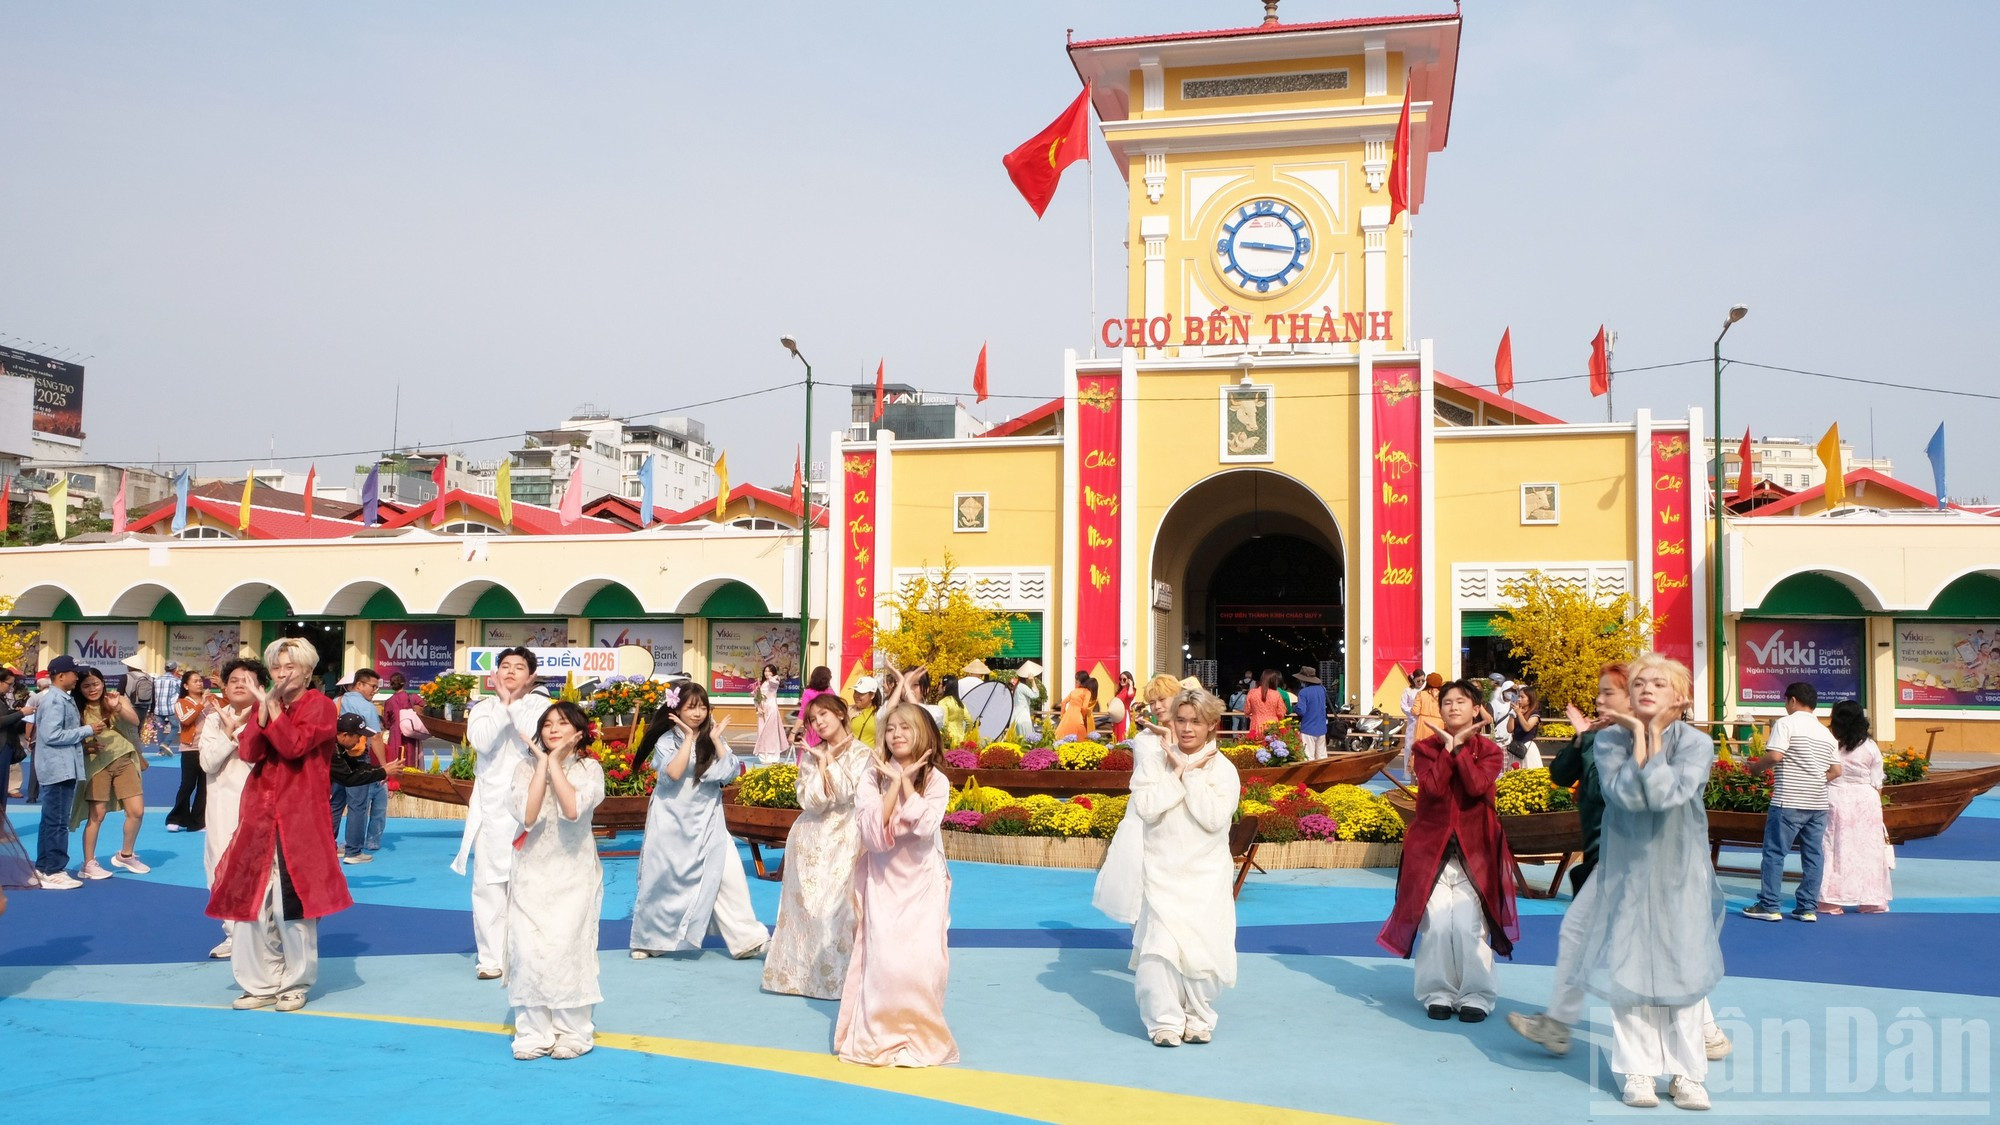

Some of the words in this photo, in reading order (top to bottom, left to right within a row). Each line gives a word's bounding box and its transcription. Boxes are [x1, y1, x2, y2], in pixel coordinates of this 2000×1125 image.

[1102, 312, 1172, 350] CHỢ
[1184, 305, 1251, 346] BẾN
[1264, 305, 1393, 344] THÀNH
[37, 388, 66, 406] 2025
[1084, 450, 1117, 468] Chúc
[1656, 475, 1684, 492] Chợ
[1660, 504, 1680, 524] Vui
[1656, 539, 1684, 556] Bến
[1381, 568, 1413, 585] 2026
[716, 628, 733, 638] Vikki
[1902, 631, 1923, 641] Vikki
[74, 630, 117, 658] Vikki
[380, 629, 428, 659] Vikki
[1746, 629, 1816, 665] Vikki
[1819, 648, 1844, 656] Digital
[430, 650, 452, 659] Bank
[547, 650, 580, 667] ĐIỀN
[583, 652, 615, 671] 2026
[654, 651, 678, 659] Bank
[1819, 656, 1851, 666] Bank
